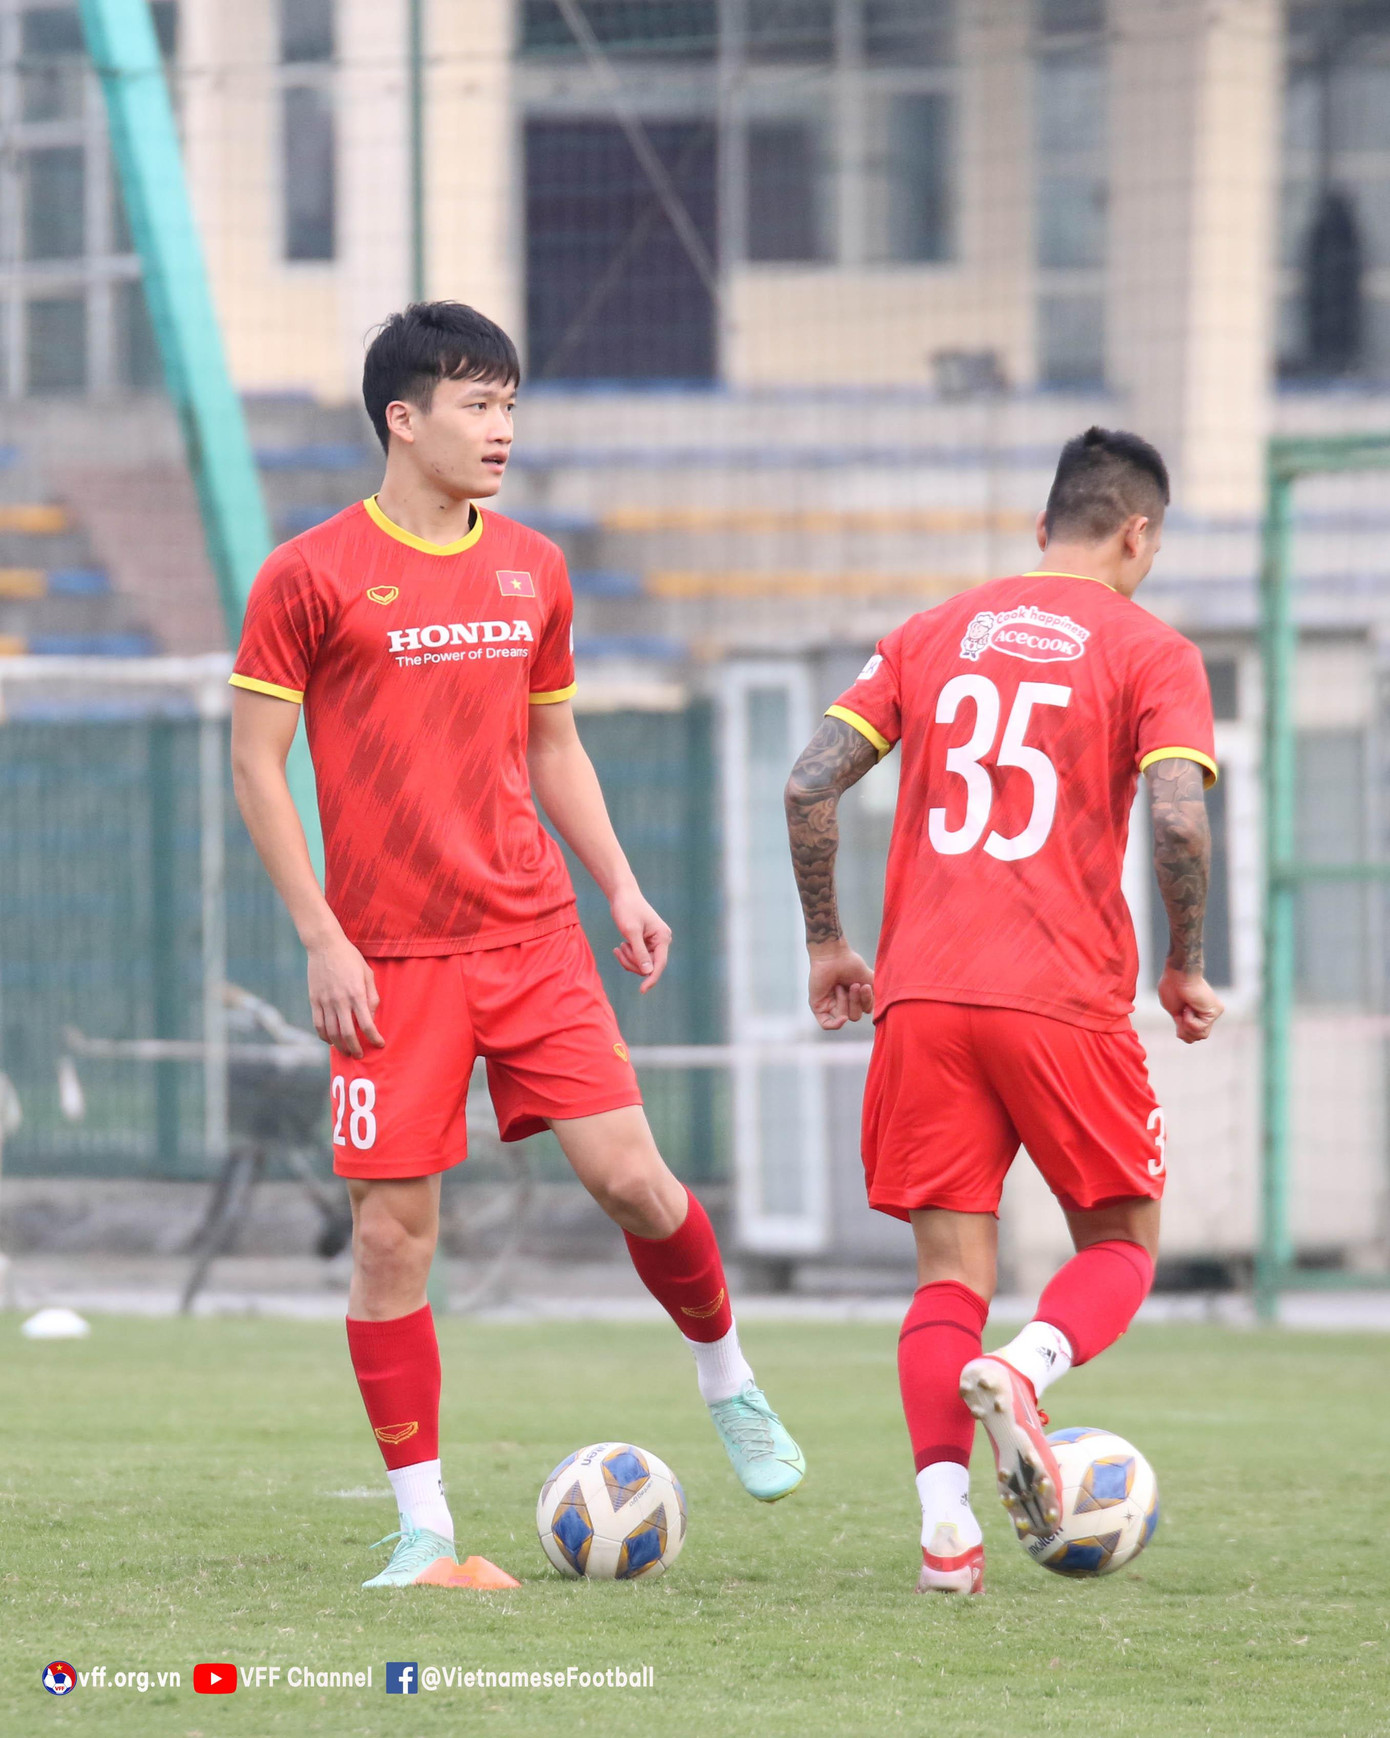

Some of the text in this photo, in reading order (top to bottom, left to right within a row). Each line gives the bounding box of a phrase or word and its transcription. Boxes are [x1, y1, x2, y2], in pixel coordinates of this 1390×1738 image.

[387, 620, 534, 653] HONDA
[1030, 609, 1087, 640] happiness
[395, 647, 529, 667] The Power of Dreams
[928, 673, 1072, 861] 35
[332, 1075, 377, 1150] 28
